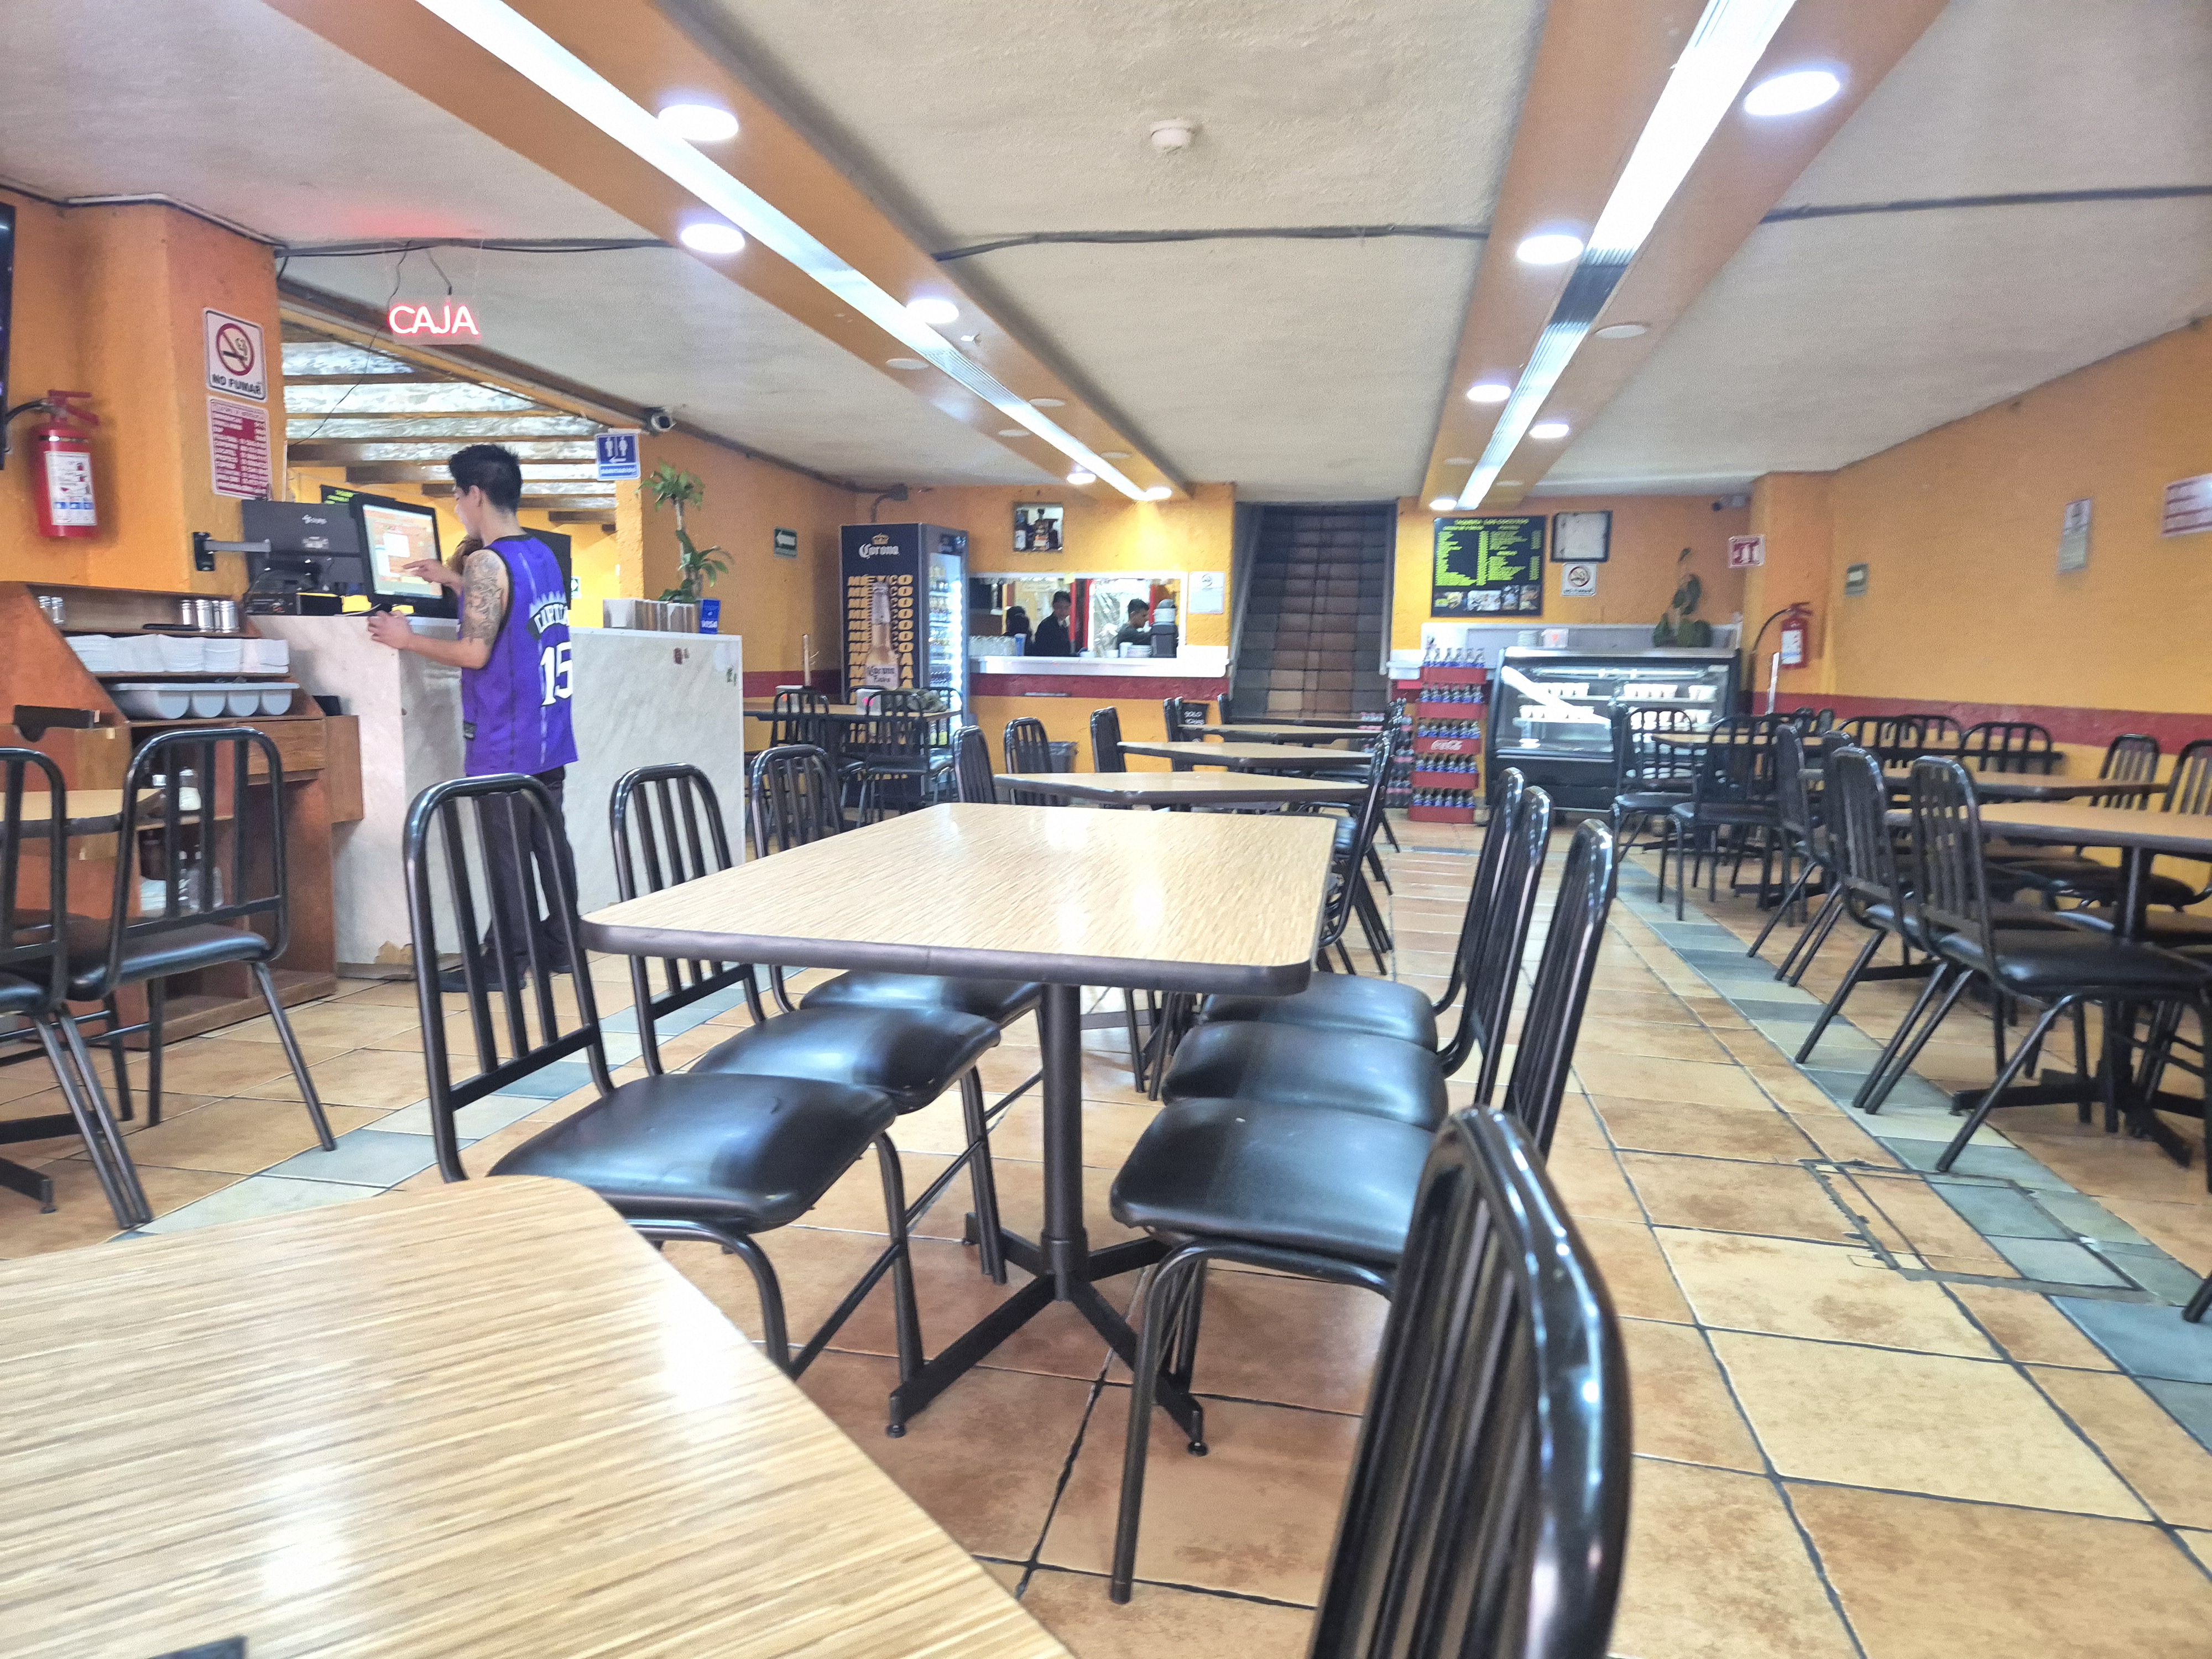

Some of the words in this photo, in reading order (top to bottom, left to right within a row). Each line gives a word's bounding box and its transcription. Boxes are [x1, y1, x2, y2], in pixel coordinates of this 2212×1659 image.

[389, 305, 479, 335] CAJA
[212, 374, 226, 385] NO
[228, 378, 261, 394] FUMAR
[859, 543, 900, 560] Corona
[701, 620, 718, 628] VISA
[540, 641, 573, 706] 15
